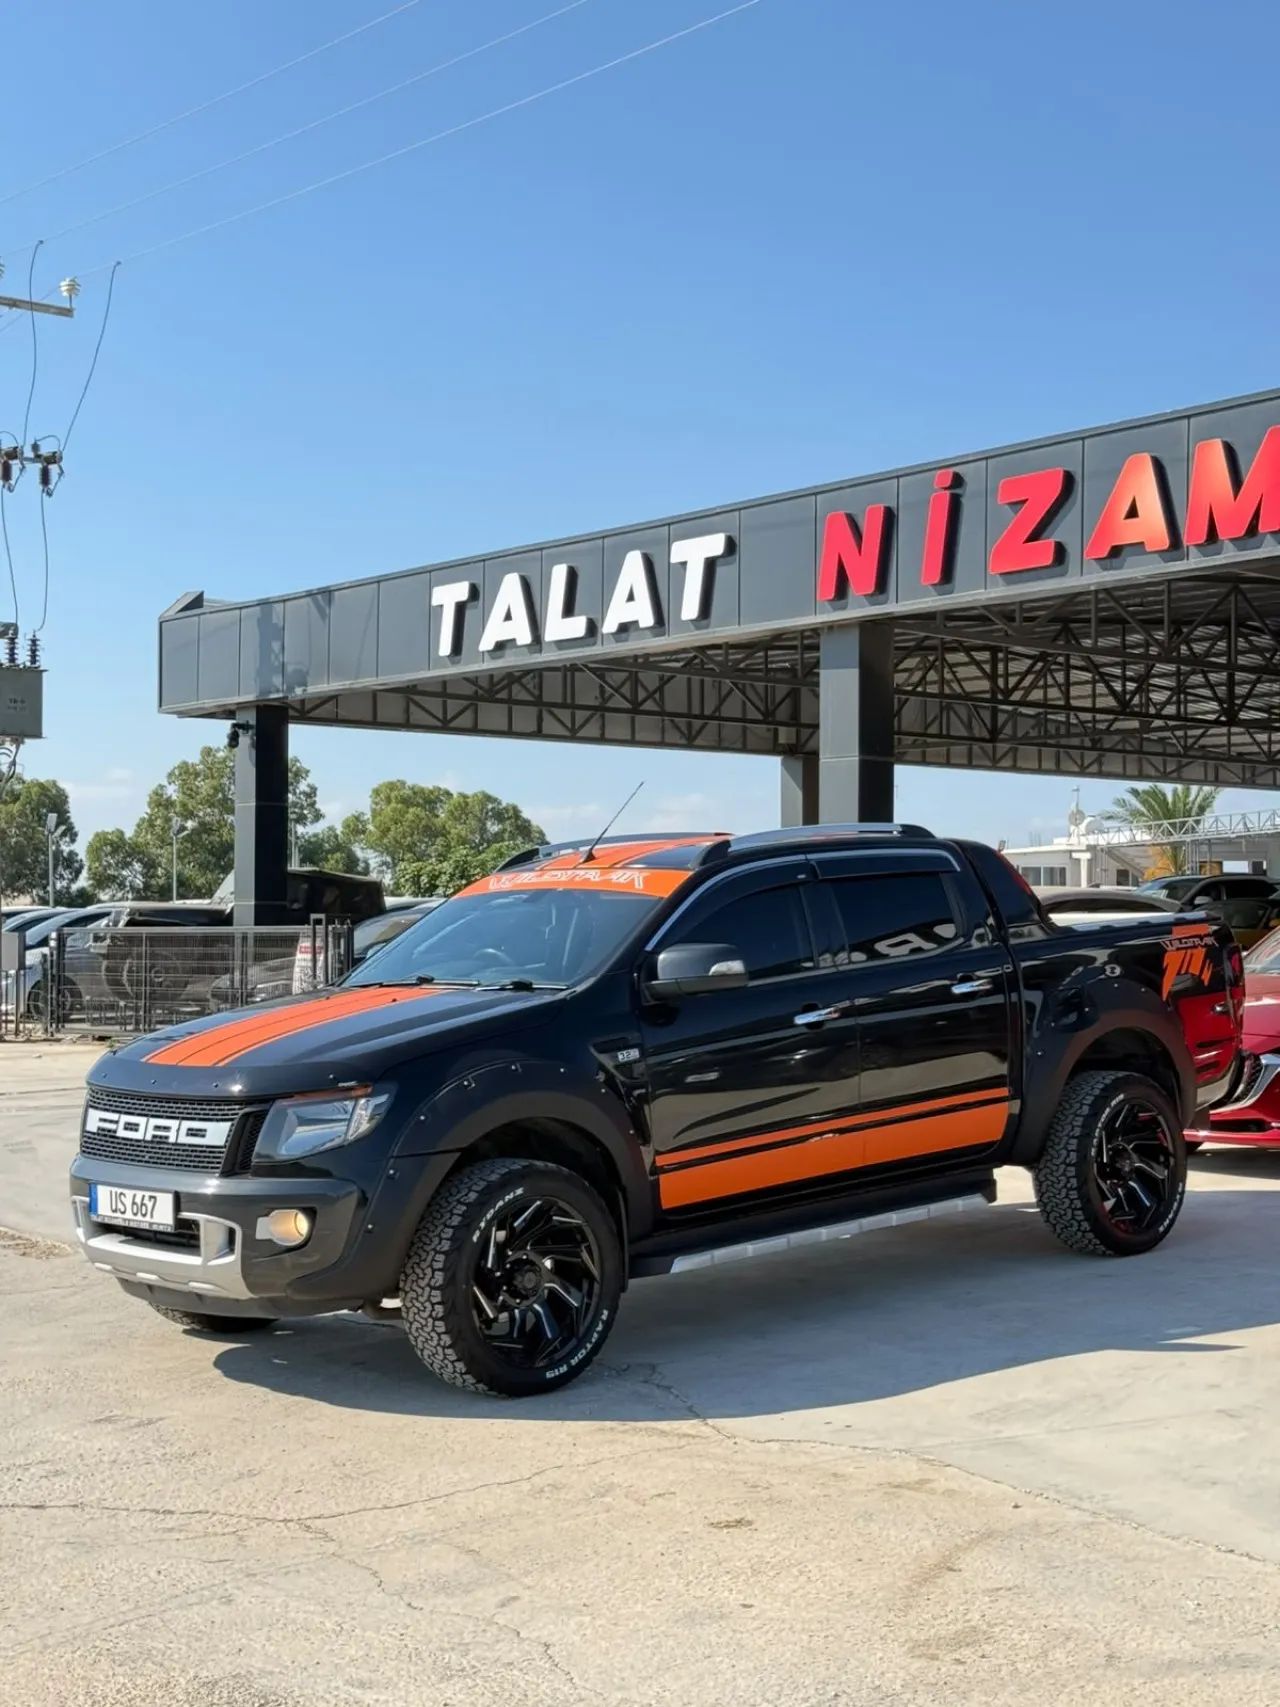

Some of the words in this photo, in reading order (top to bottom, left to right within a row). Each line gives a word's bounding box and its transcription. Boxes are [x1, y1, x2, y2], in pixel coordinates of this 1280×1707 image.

[432, 533, 728, 657] TALAT
[86, 1108, 233, 1146] FORD
[109, 1190, 127, 1214] US
[131, 1193, 157, 1219] 667
[570, 1309, 608, 1366] RAPTOR
